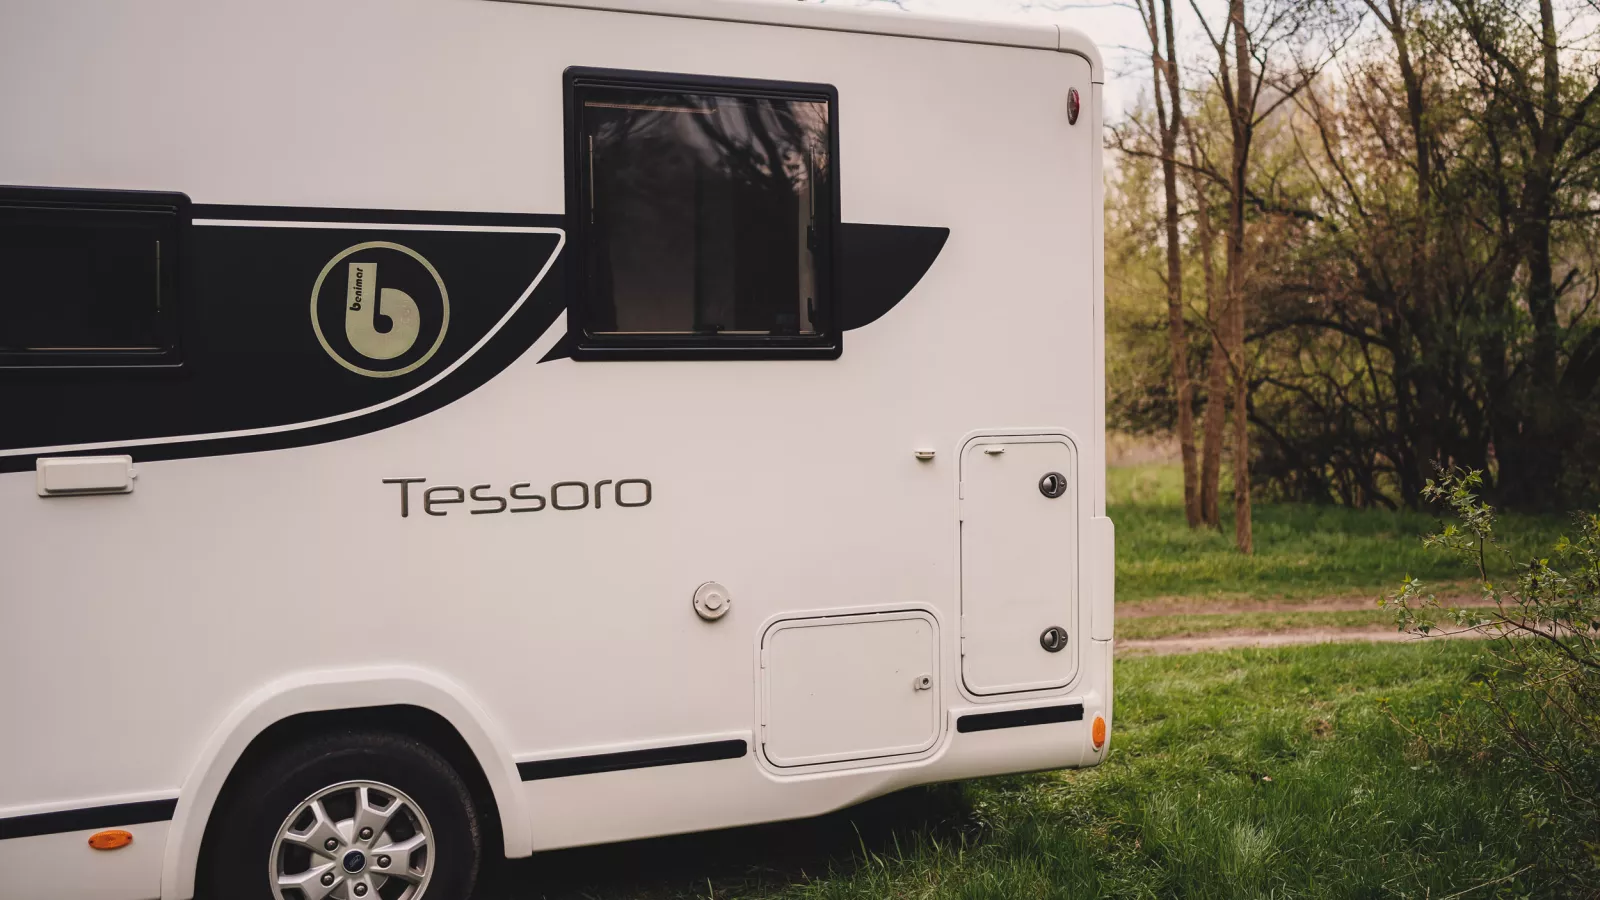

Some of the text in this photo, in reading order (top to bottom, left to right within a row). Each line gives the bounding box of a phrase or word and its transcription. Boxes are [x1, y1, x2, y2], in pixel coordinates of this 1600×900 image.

[345, 262, 421, 360] b
[349, 267, 364, 312] benimar
[381, 477, 652, 518] Tessoro
